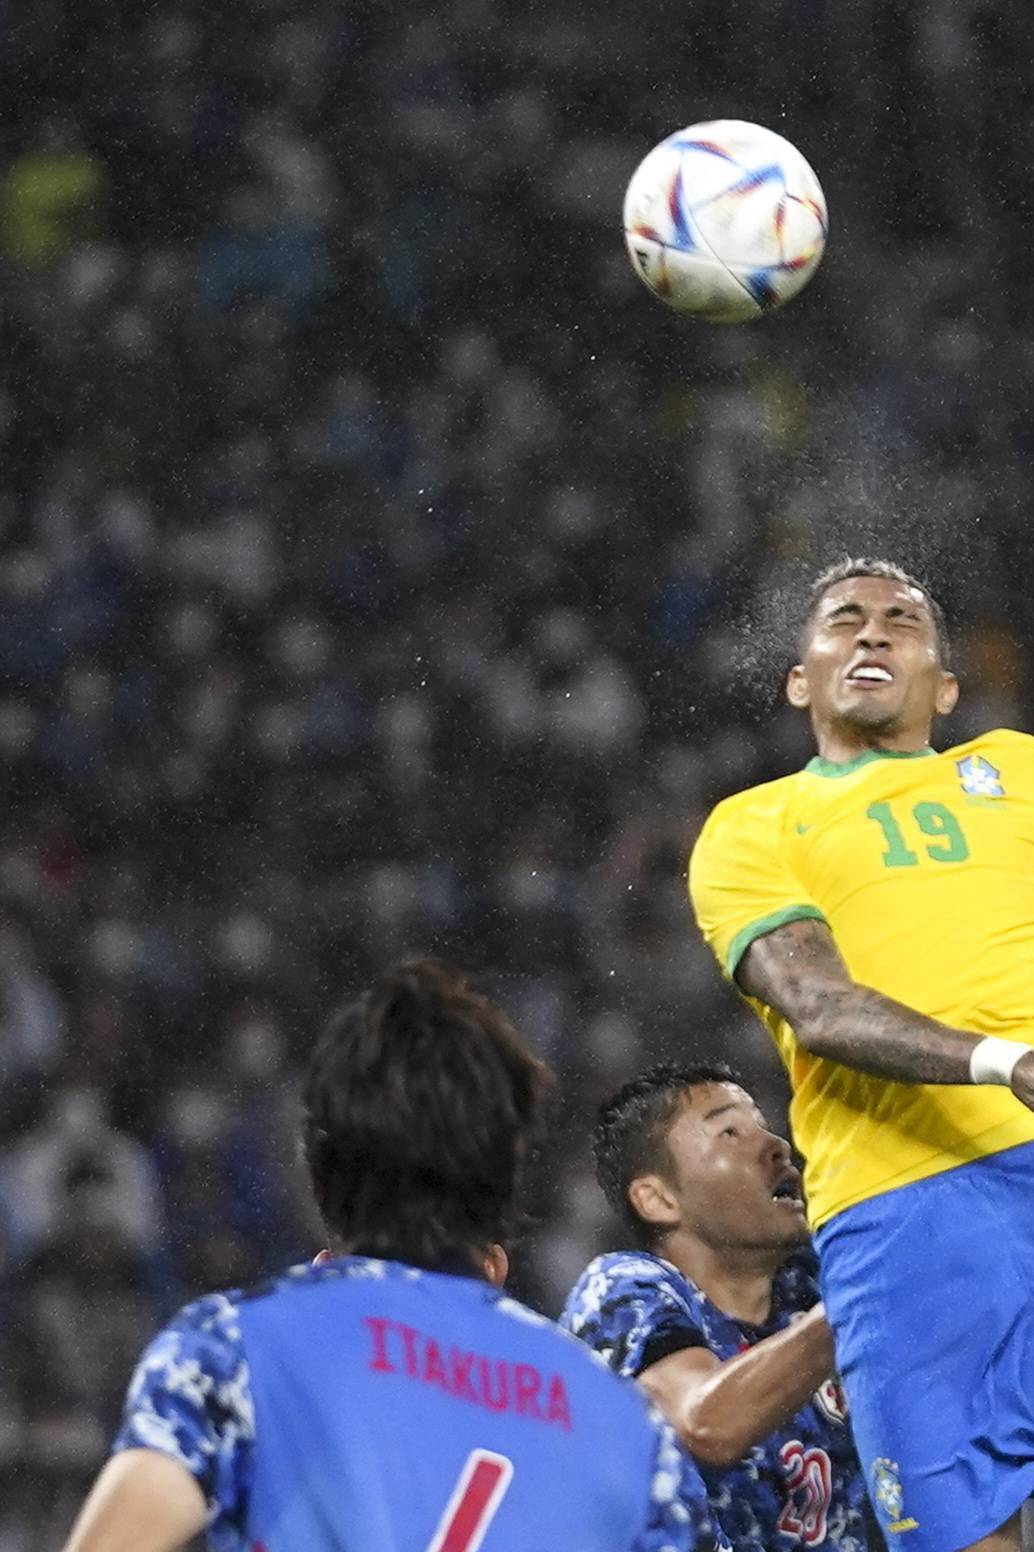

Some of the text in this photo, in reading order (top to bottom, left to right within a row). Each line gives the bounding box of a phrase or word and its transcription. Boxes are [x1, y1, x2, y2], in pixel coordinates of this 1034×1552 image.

[867, 801, 970, 867] 19
[362, 1316, 573, 1432] ITAKURA
[777, 1439, 832, 1547] 20
